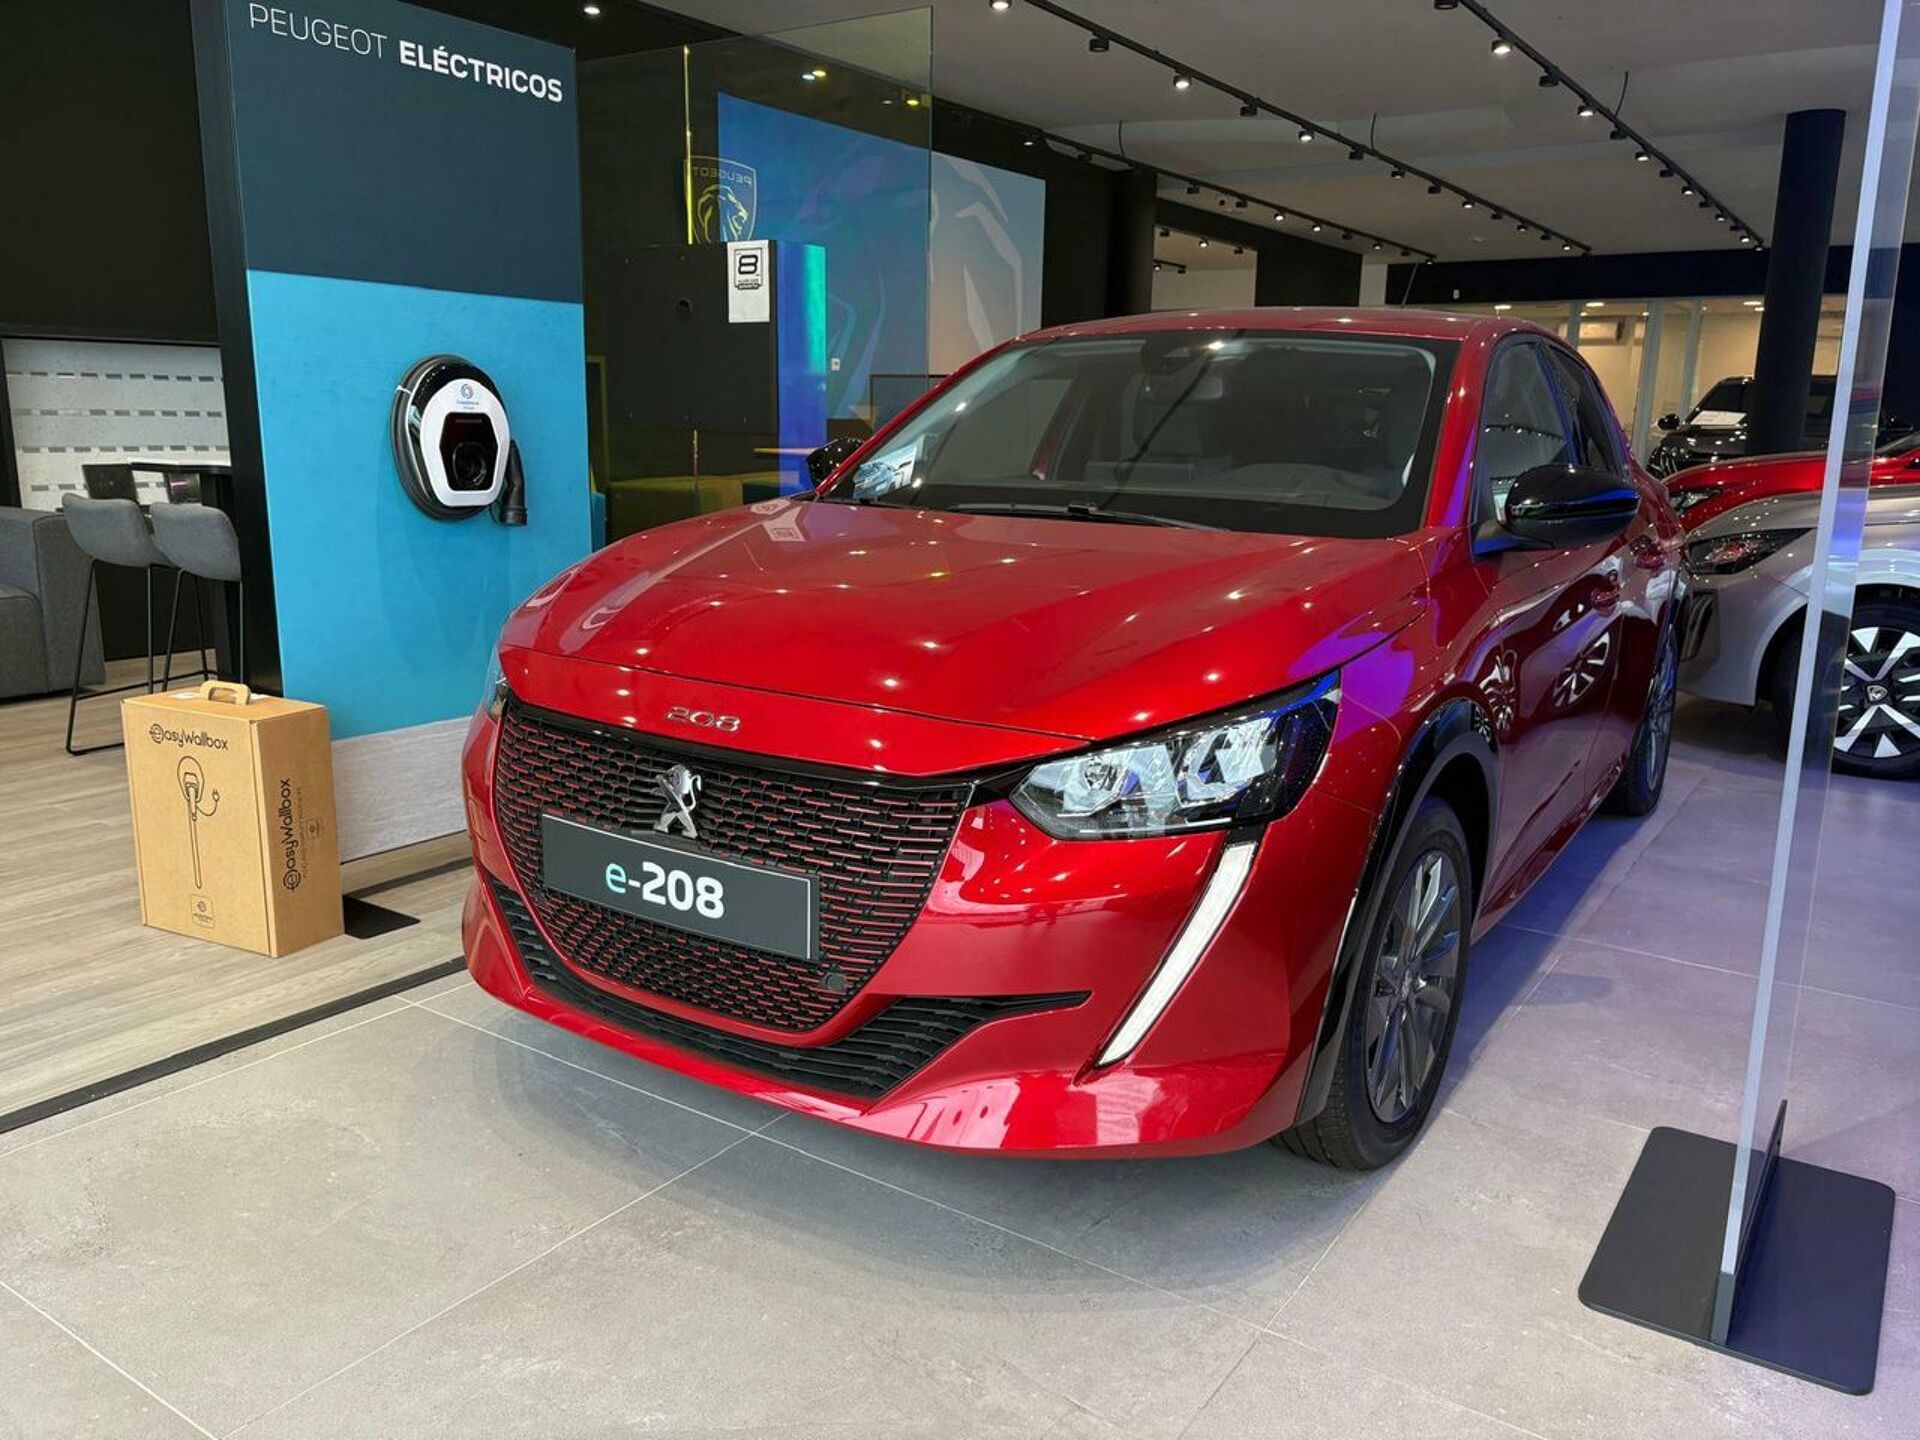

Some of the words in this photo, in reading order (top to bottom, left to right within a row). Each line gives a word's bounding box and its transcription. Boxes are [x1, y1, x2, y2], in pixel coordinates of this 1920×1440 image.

[249, 3, 388, 59] PEUGEOT
[399, 40, 563, 103] ELÉCTRICOS
[738, 254, 758, 275] 8
[665, 706, 741, 733] 208
[605, 861, 725, 919] e-208
